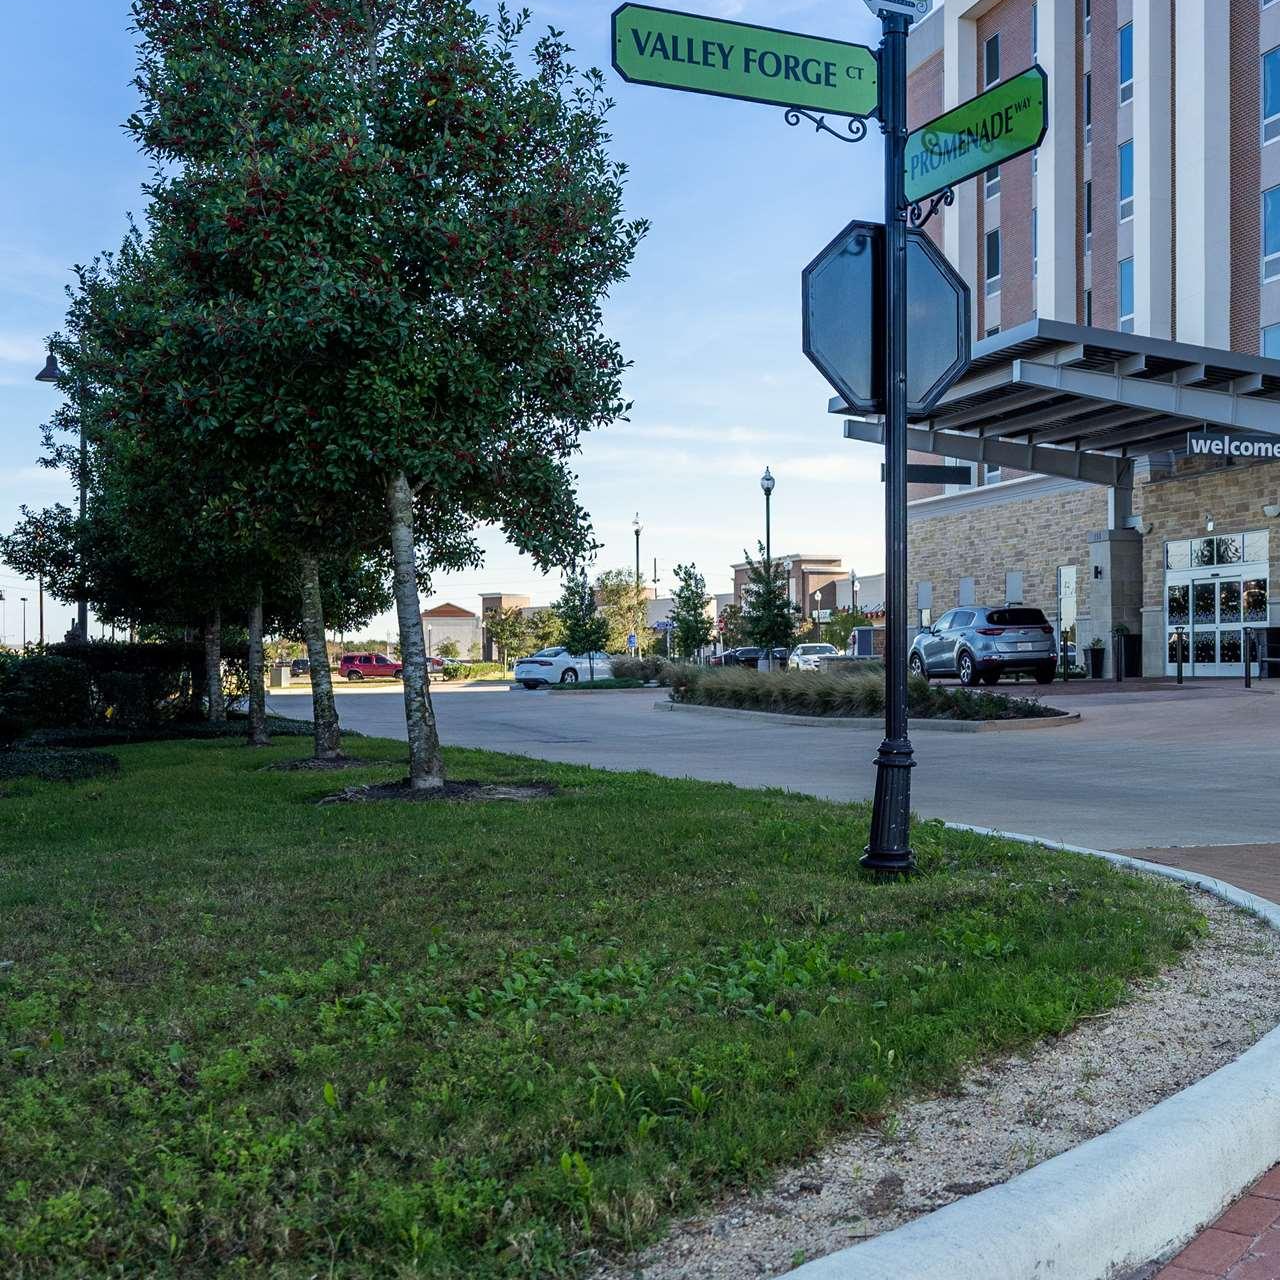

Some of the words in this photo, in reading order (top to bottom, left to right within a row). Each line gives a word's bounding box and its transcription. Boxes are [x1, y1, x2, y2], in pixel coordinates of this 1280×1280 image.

[631, 28, 737, 70] VALLEY
[743, 47, 837, 88] FORGE
[845, 65, 865, 81] CT
[910, 105, 1015, 180] PROMENADE
[1014, 96, 1032, 114] WAY
